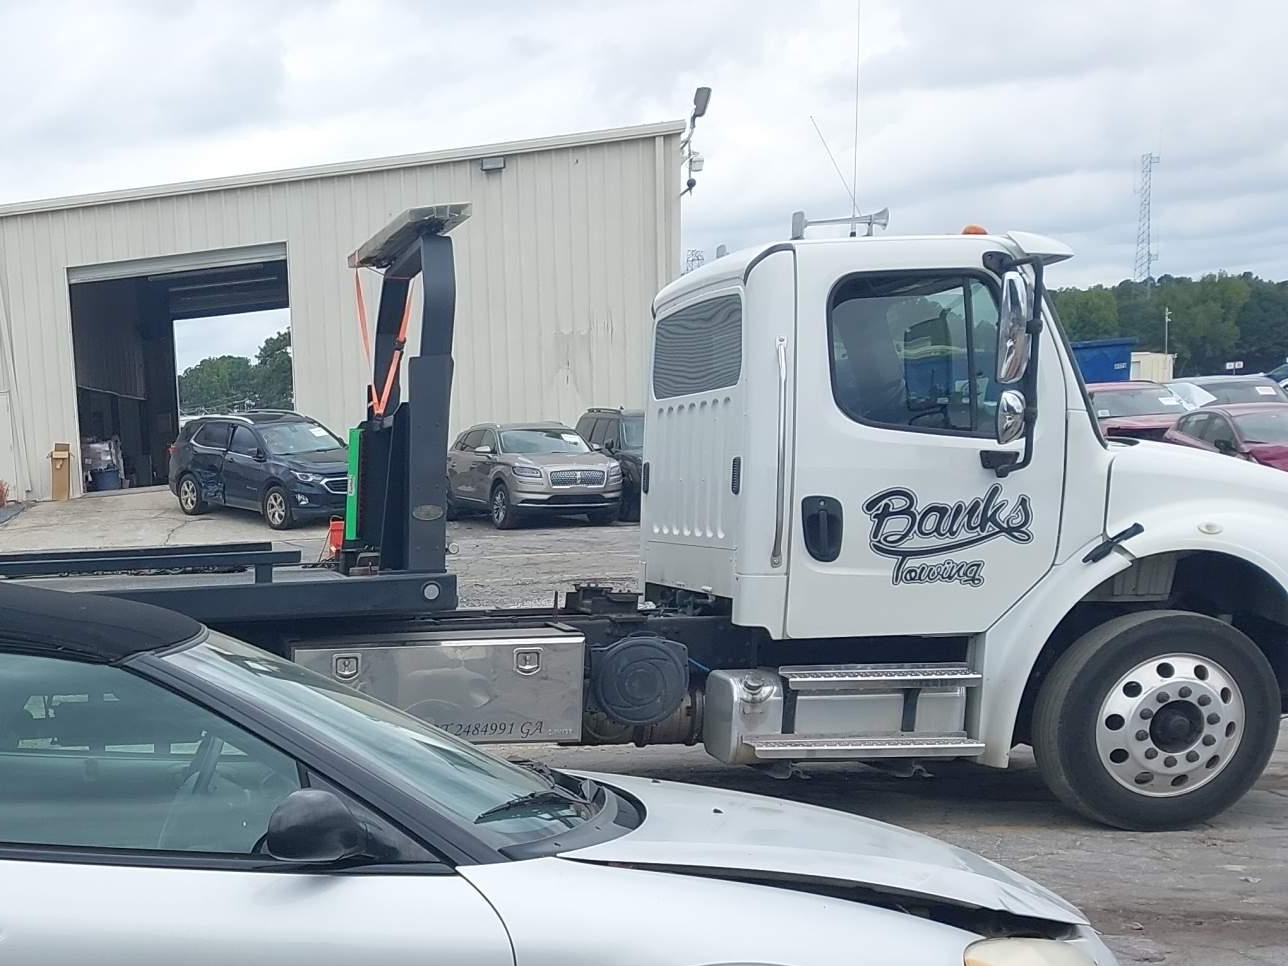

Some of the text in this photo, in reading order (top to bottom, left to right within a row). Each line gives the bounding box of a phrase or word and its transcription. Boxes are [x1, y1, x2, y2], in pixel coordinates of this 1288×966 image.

[862, 483, 1034, 546] Banks
[892, 555, 984, 587] Towing
[454, 721, 514, 736] 2484991
[520, 720, 544, 739] GA
